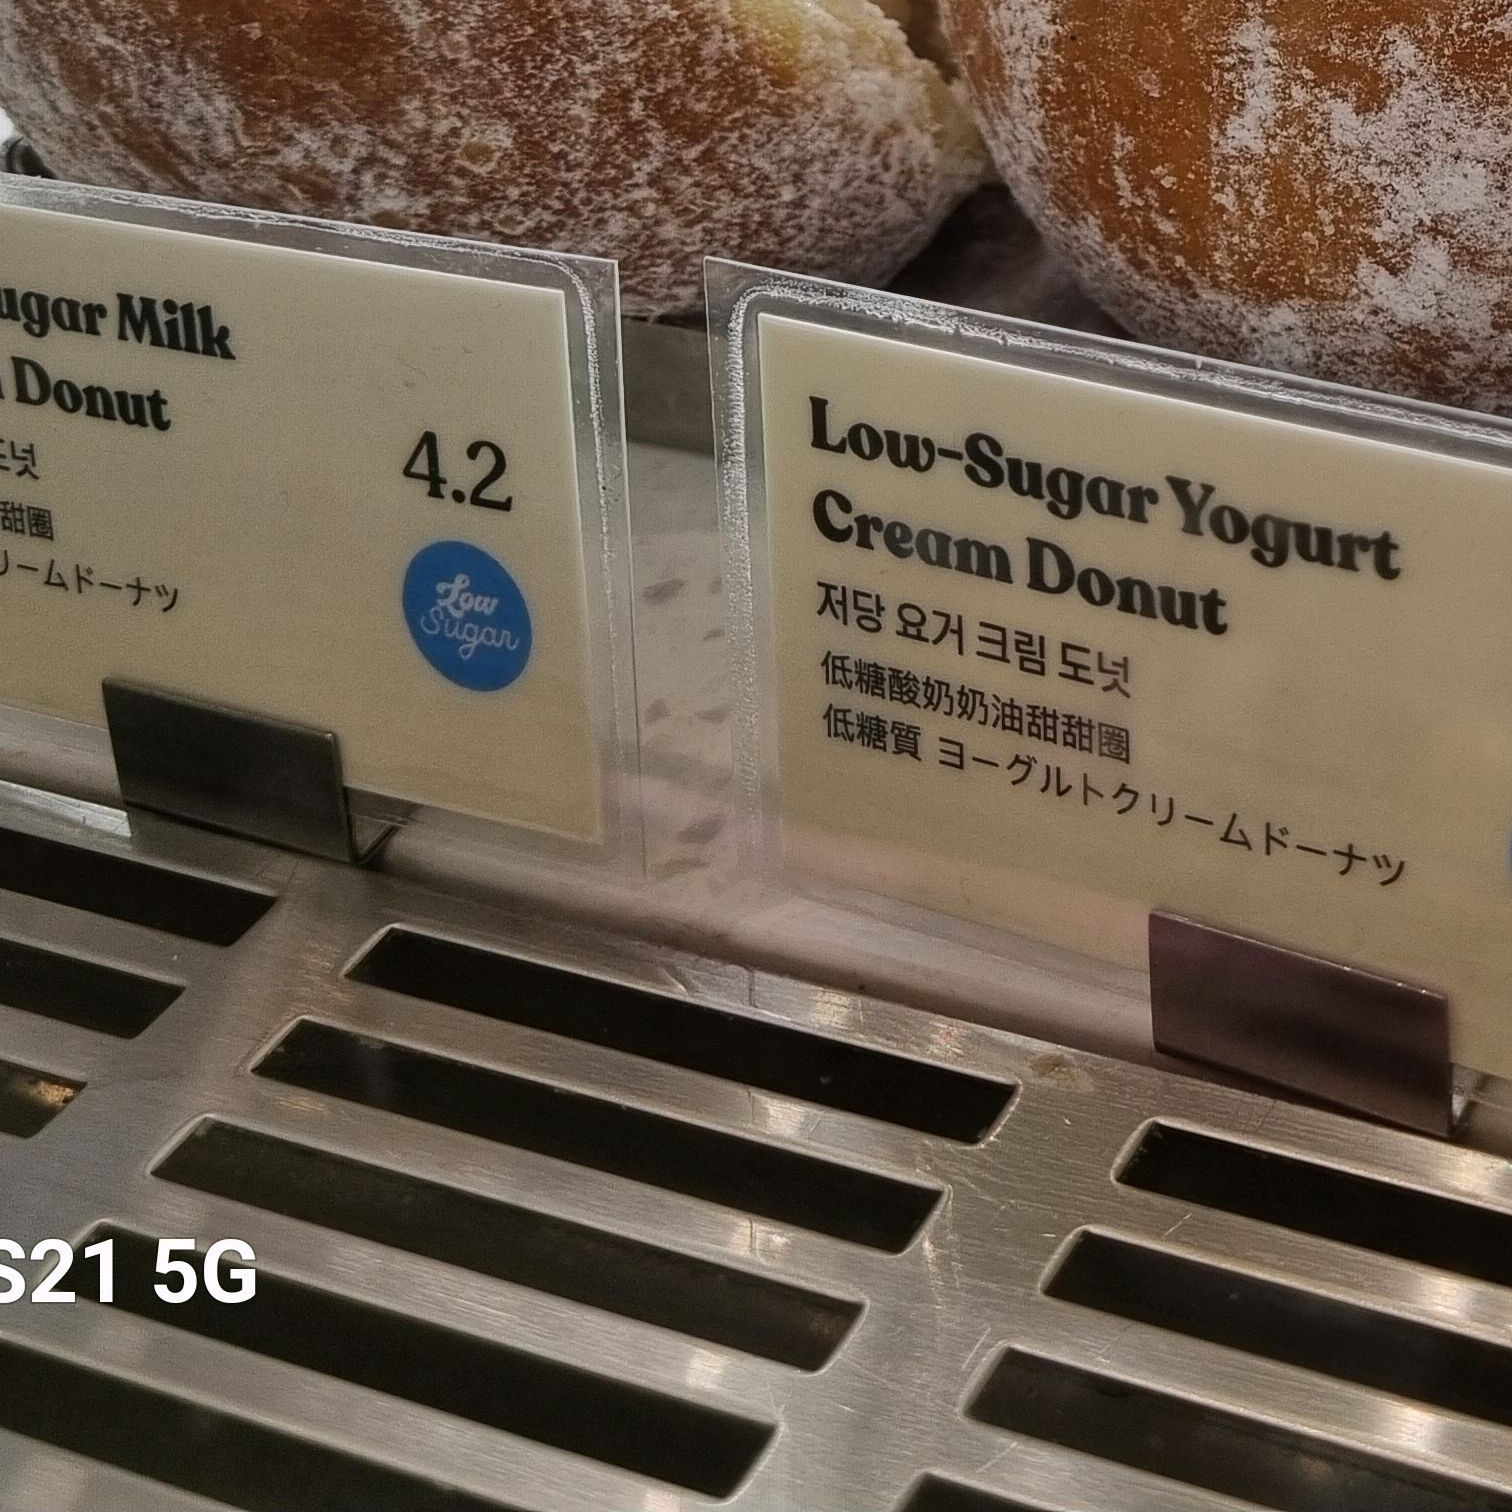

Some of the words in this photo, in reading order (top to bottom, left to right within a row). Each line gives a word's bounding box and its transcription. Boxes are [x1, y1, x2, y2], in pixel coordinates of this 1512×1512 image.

[116, 293, 236, 360] Milk
[10, 356, 171, 431] Donut
[402, 430, 513, 512] 4.2
[809, 396, 1158, 522] Low-Sugar
[1165, 475, 1401, 580] Yogurt
[436, 574, 500, 617] Low
[812, 490, 1014, 584] Cream
[1026, 536, 1229, 635] Donut
[420, 606, 519, 659] Sugar
[817, 580, 885, 634] 저당
[895, 602, 964, 656] 요거
[976, 621, 1046, 676] 크림
[1058, 641, 1131, 699] 도넛
[820, 650, 1131, 765] 低糖酸奶奶油甜甜圈
